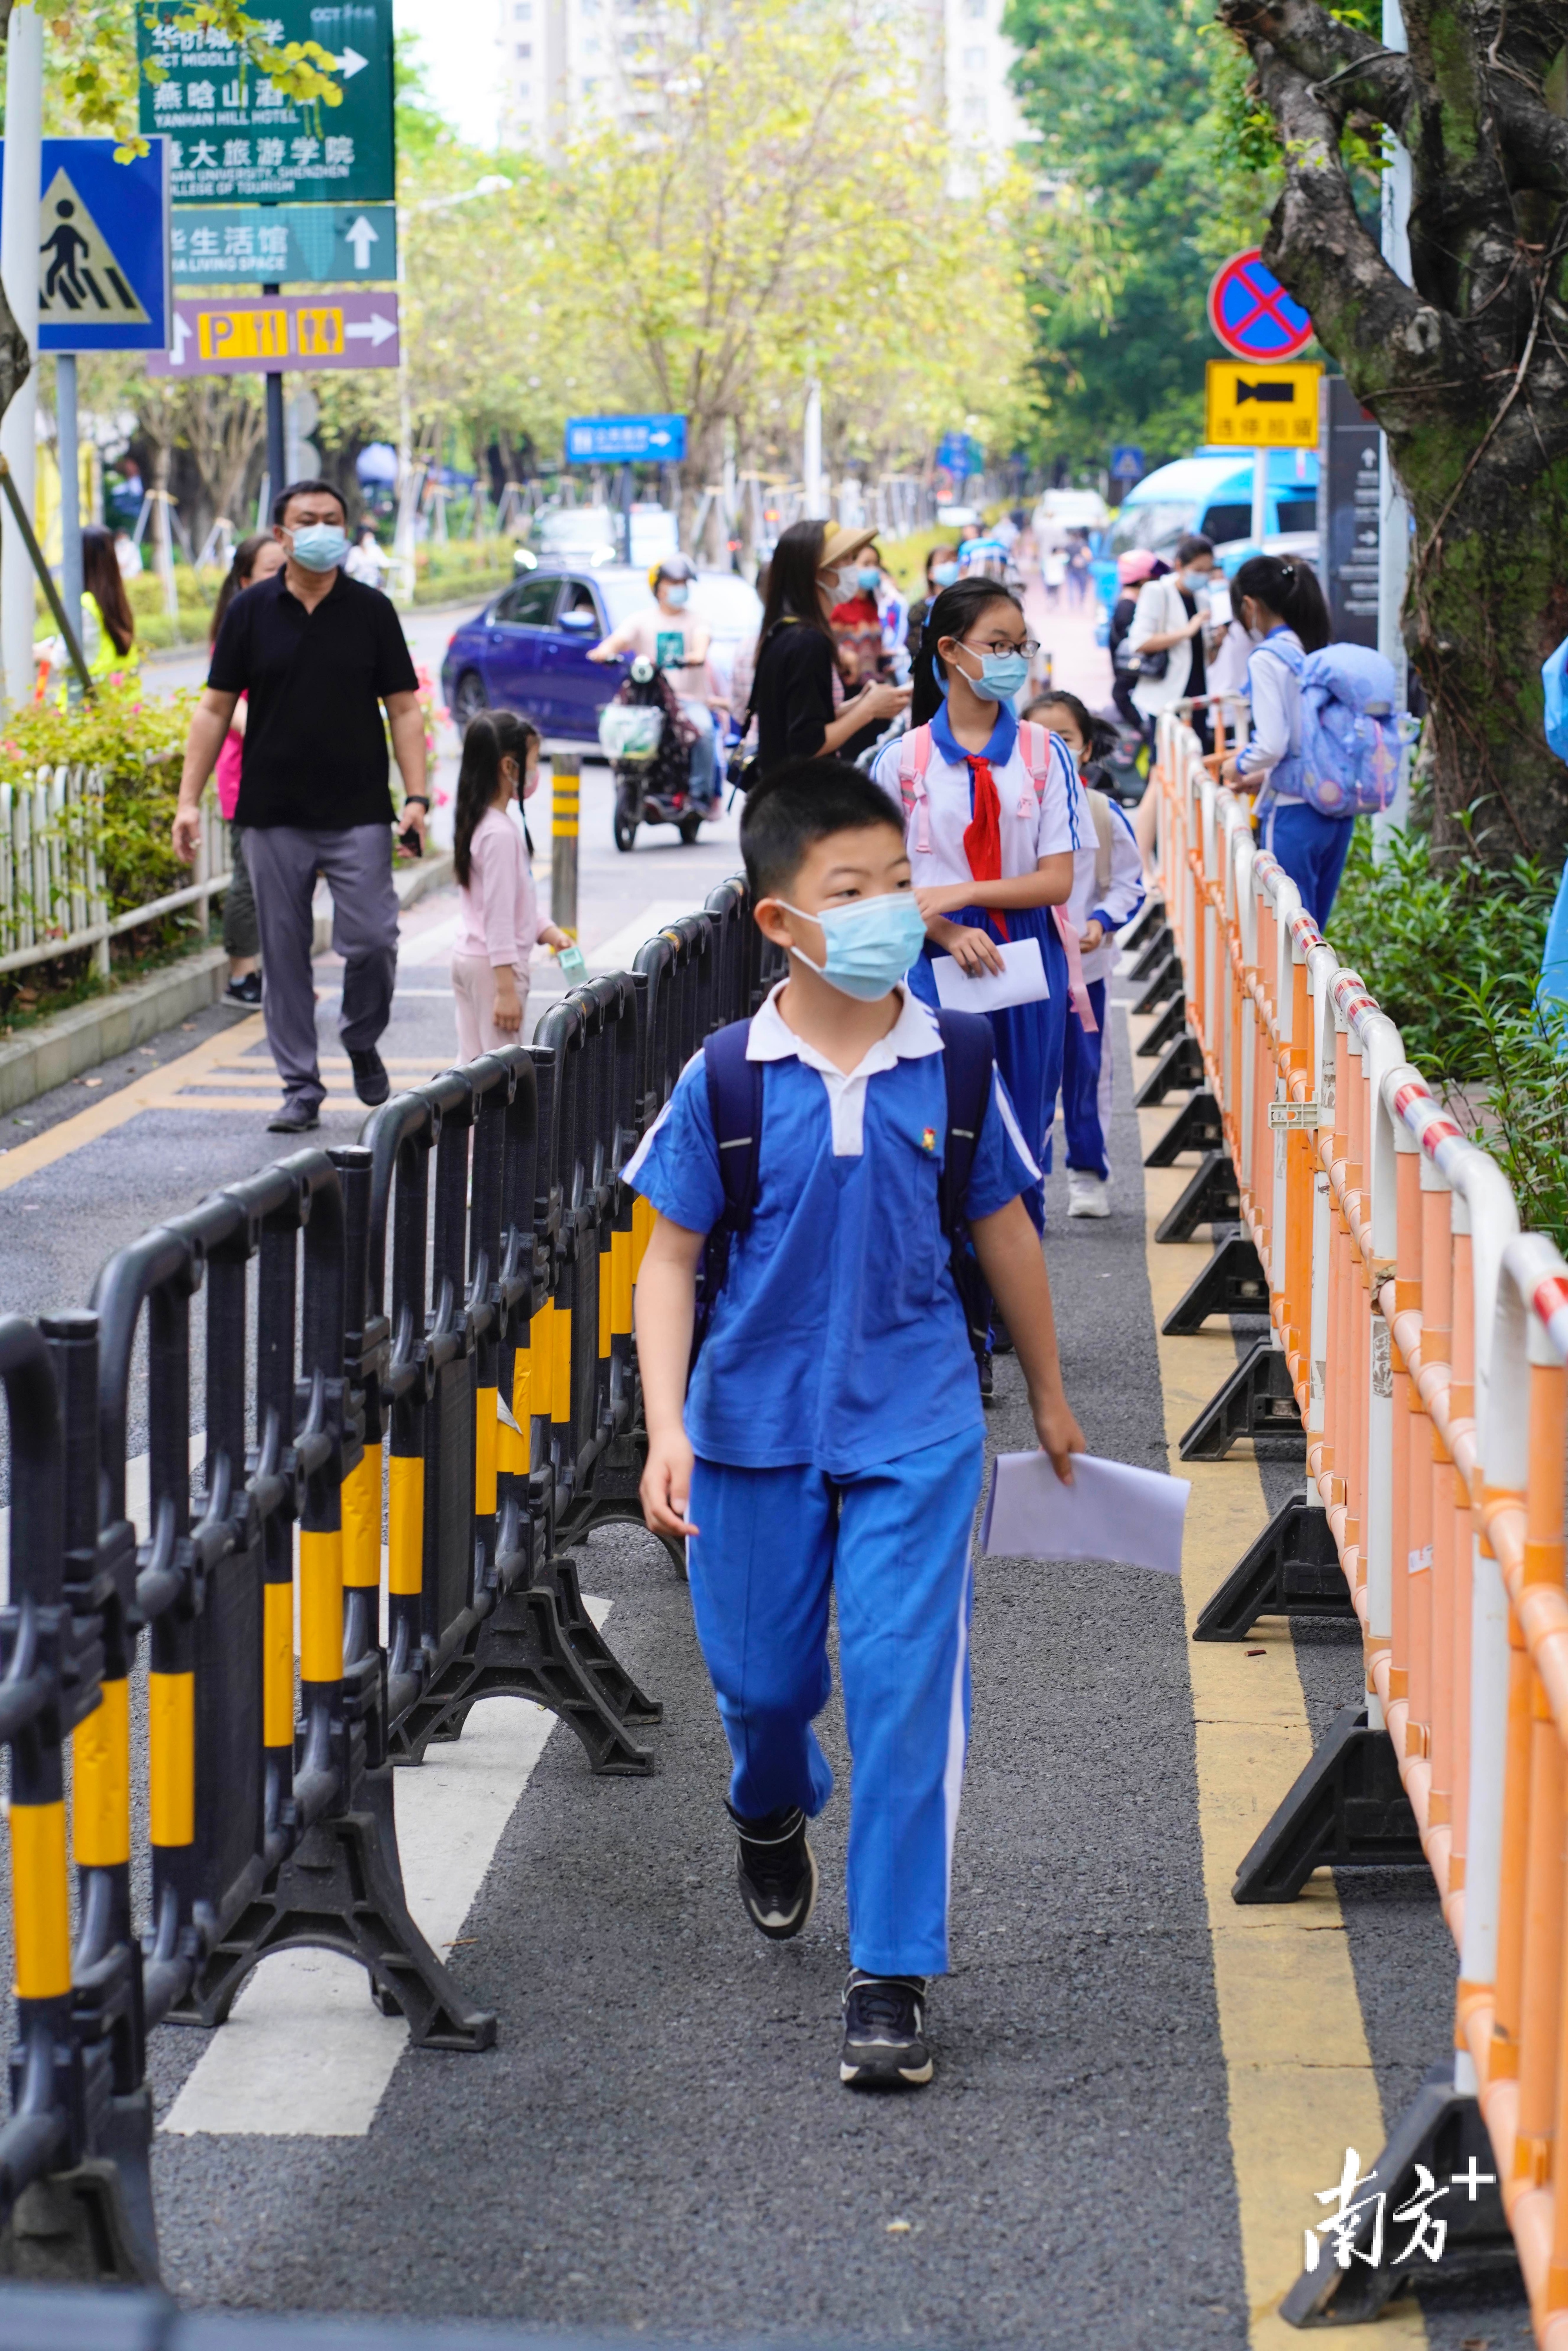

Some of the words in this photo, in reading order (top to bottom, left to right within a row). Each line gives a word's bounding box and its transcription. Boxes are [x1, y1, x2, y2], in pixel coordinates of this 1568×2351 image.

[152, 19, 285, 52] 华侨城学
[181, 51, 238, 67] MIDDLE
[153, 79, 317, 111] 燕晗山酒
[216, 110, 250, 126] HILL
[211, 316, 233, 355] P
